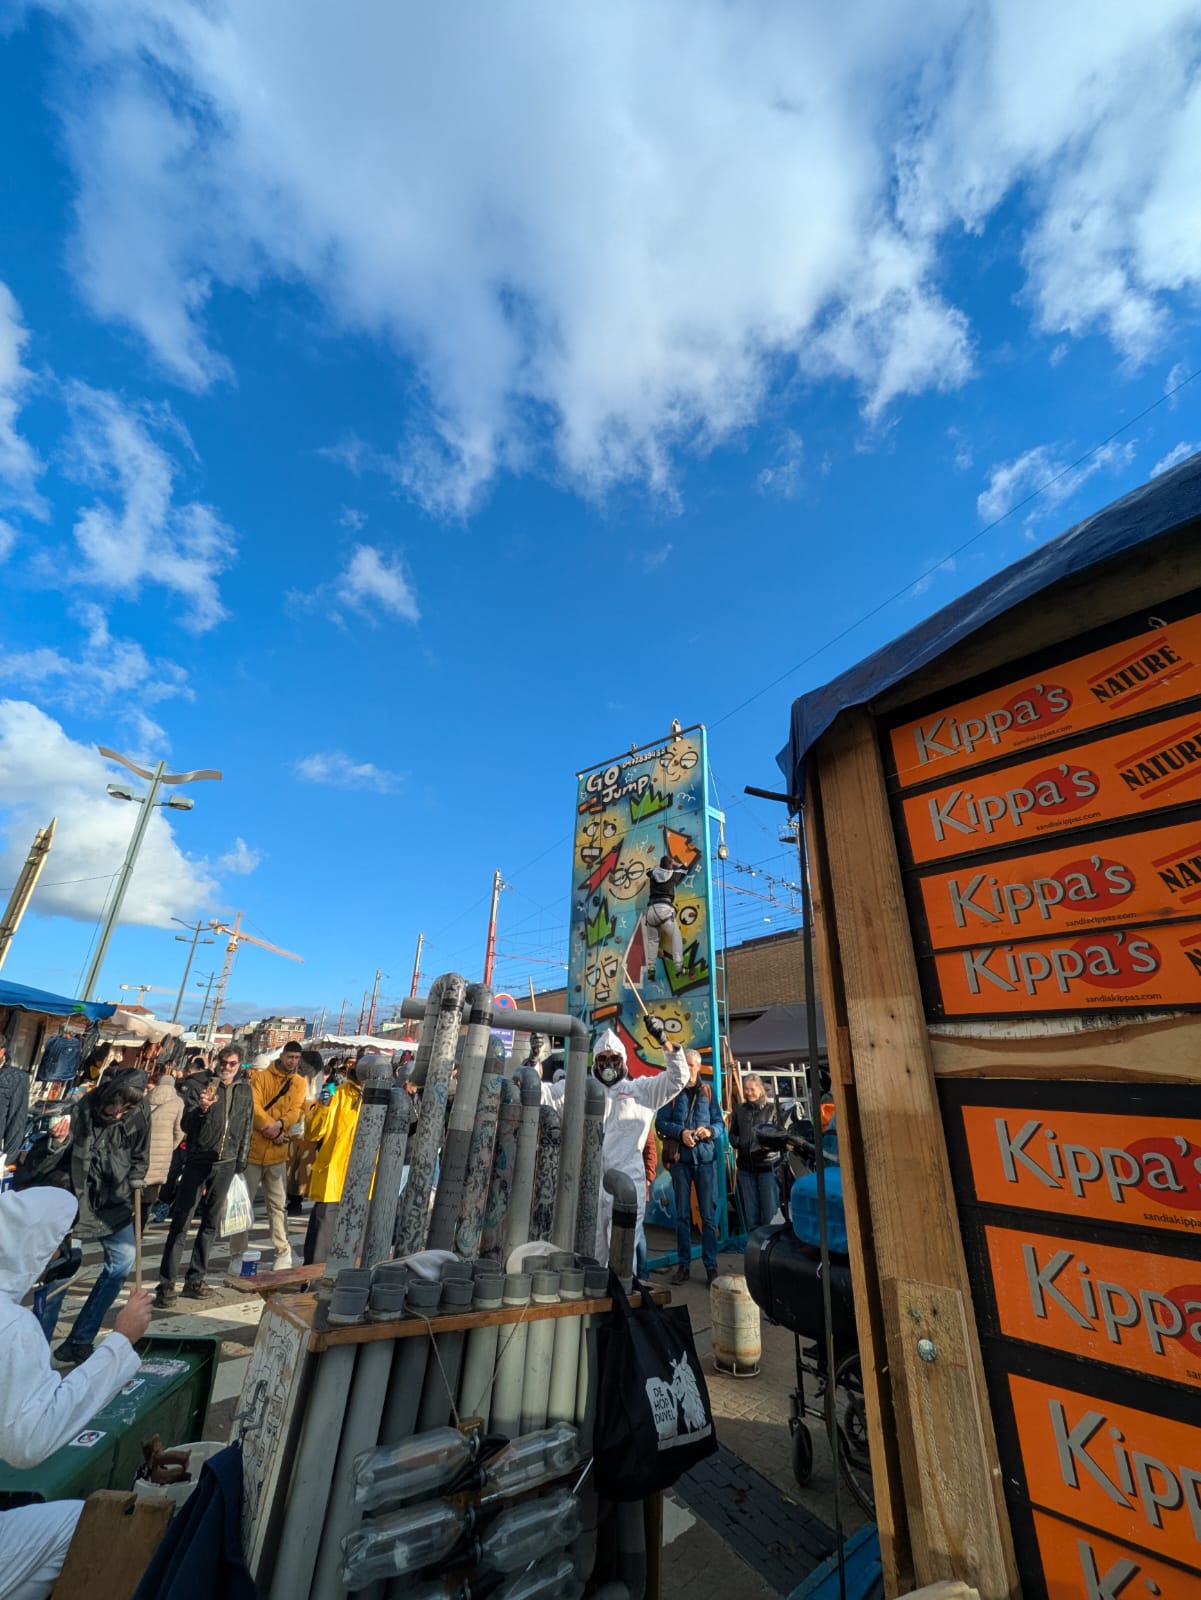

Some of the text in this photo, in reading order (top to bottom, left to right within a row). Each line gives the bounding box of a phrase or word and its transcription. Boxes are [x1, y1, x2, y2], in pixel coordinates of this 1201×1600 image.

[1089, 645, 1182, 703] NATURE
[912, 684, 1071, 764] Kippa's
[586, 765, 620, 792] GO
[928, 764, 1098, 842] Kippa's
[948, 855, 1134, 928] Kippa's
[962, 931, 1160, 995] Kippa's
[653, 1387, 664, 1398] DE
[655, 1410, 676, 1424] DUVEL
